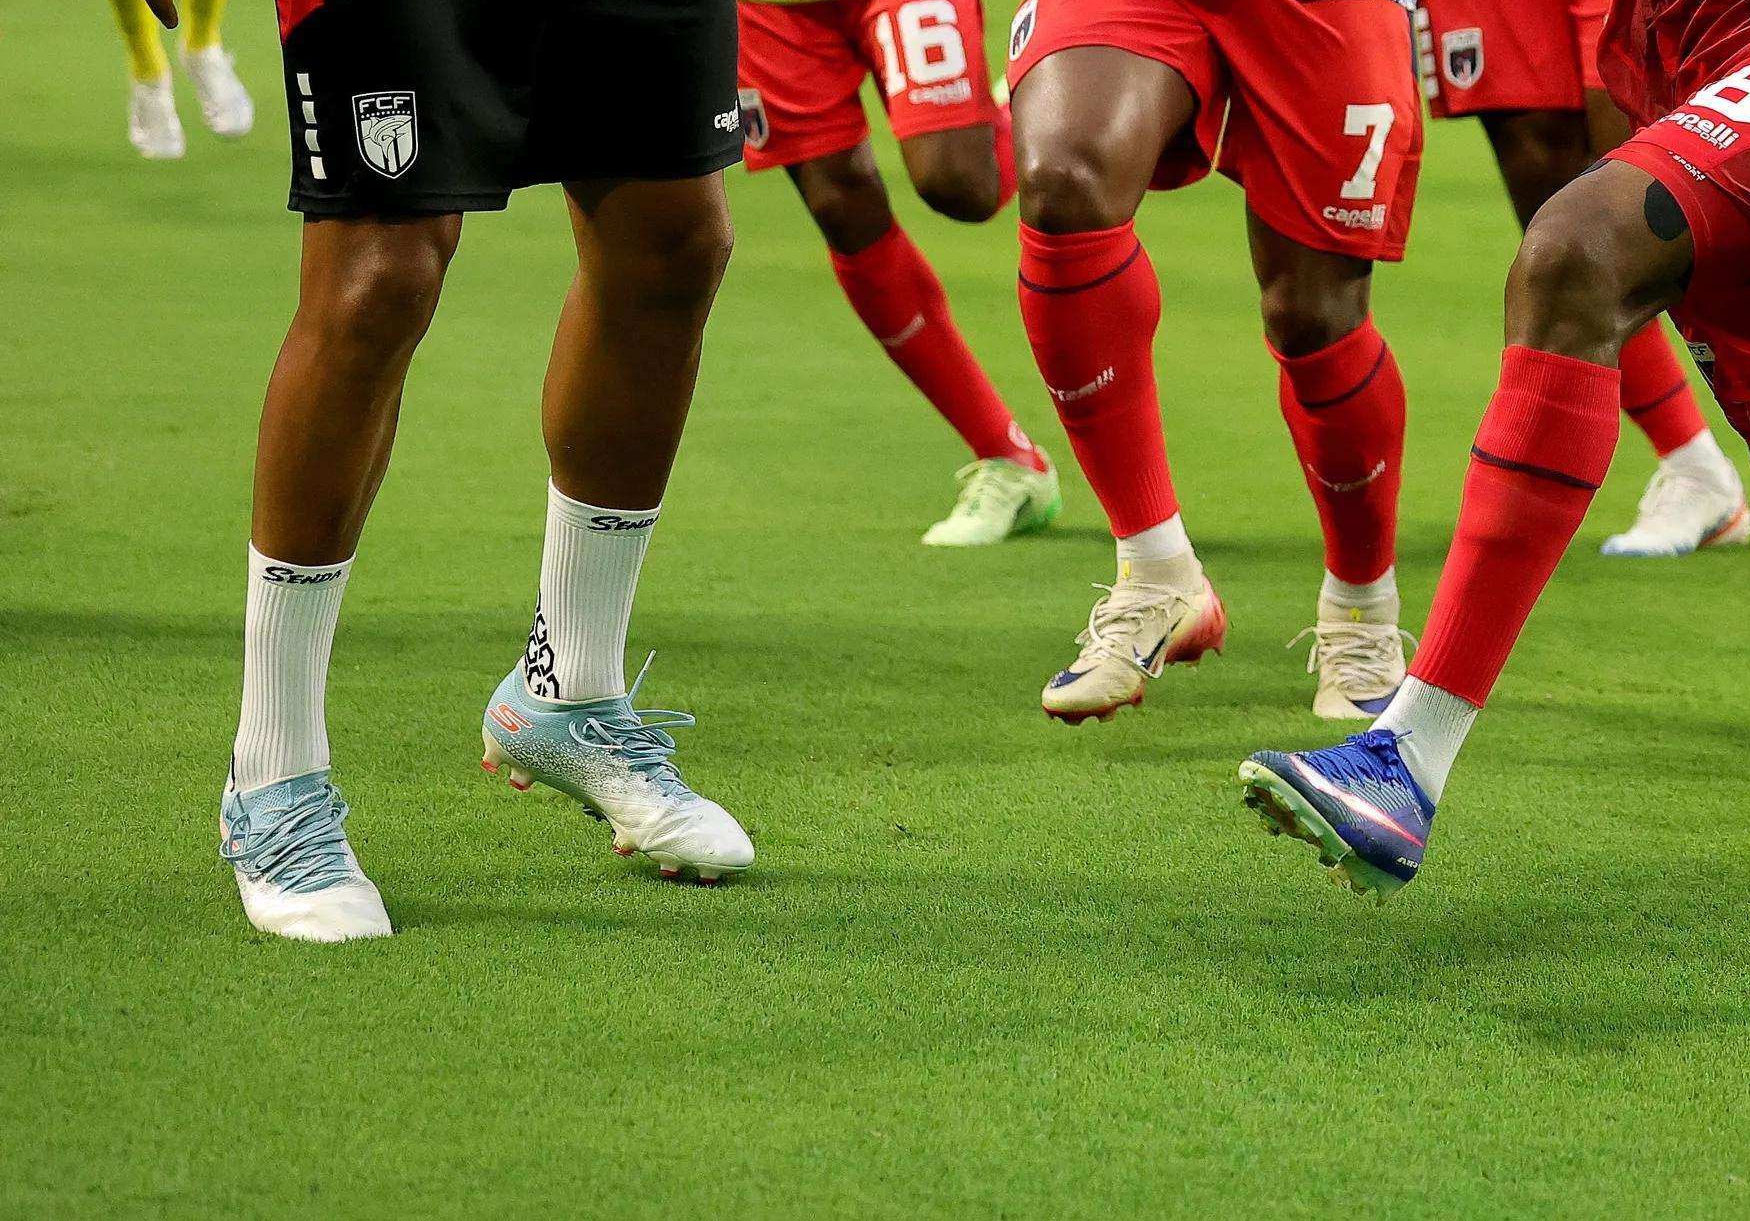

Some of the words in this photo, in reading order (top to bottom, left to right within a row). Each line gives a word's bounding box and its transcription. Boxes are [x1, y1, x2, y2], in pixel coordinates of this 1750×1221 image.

[359, 96, 410, 113] FCF
[1682, 123, 1727, 151] SPORT
[1340, 103, 1396, 200] 7
